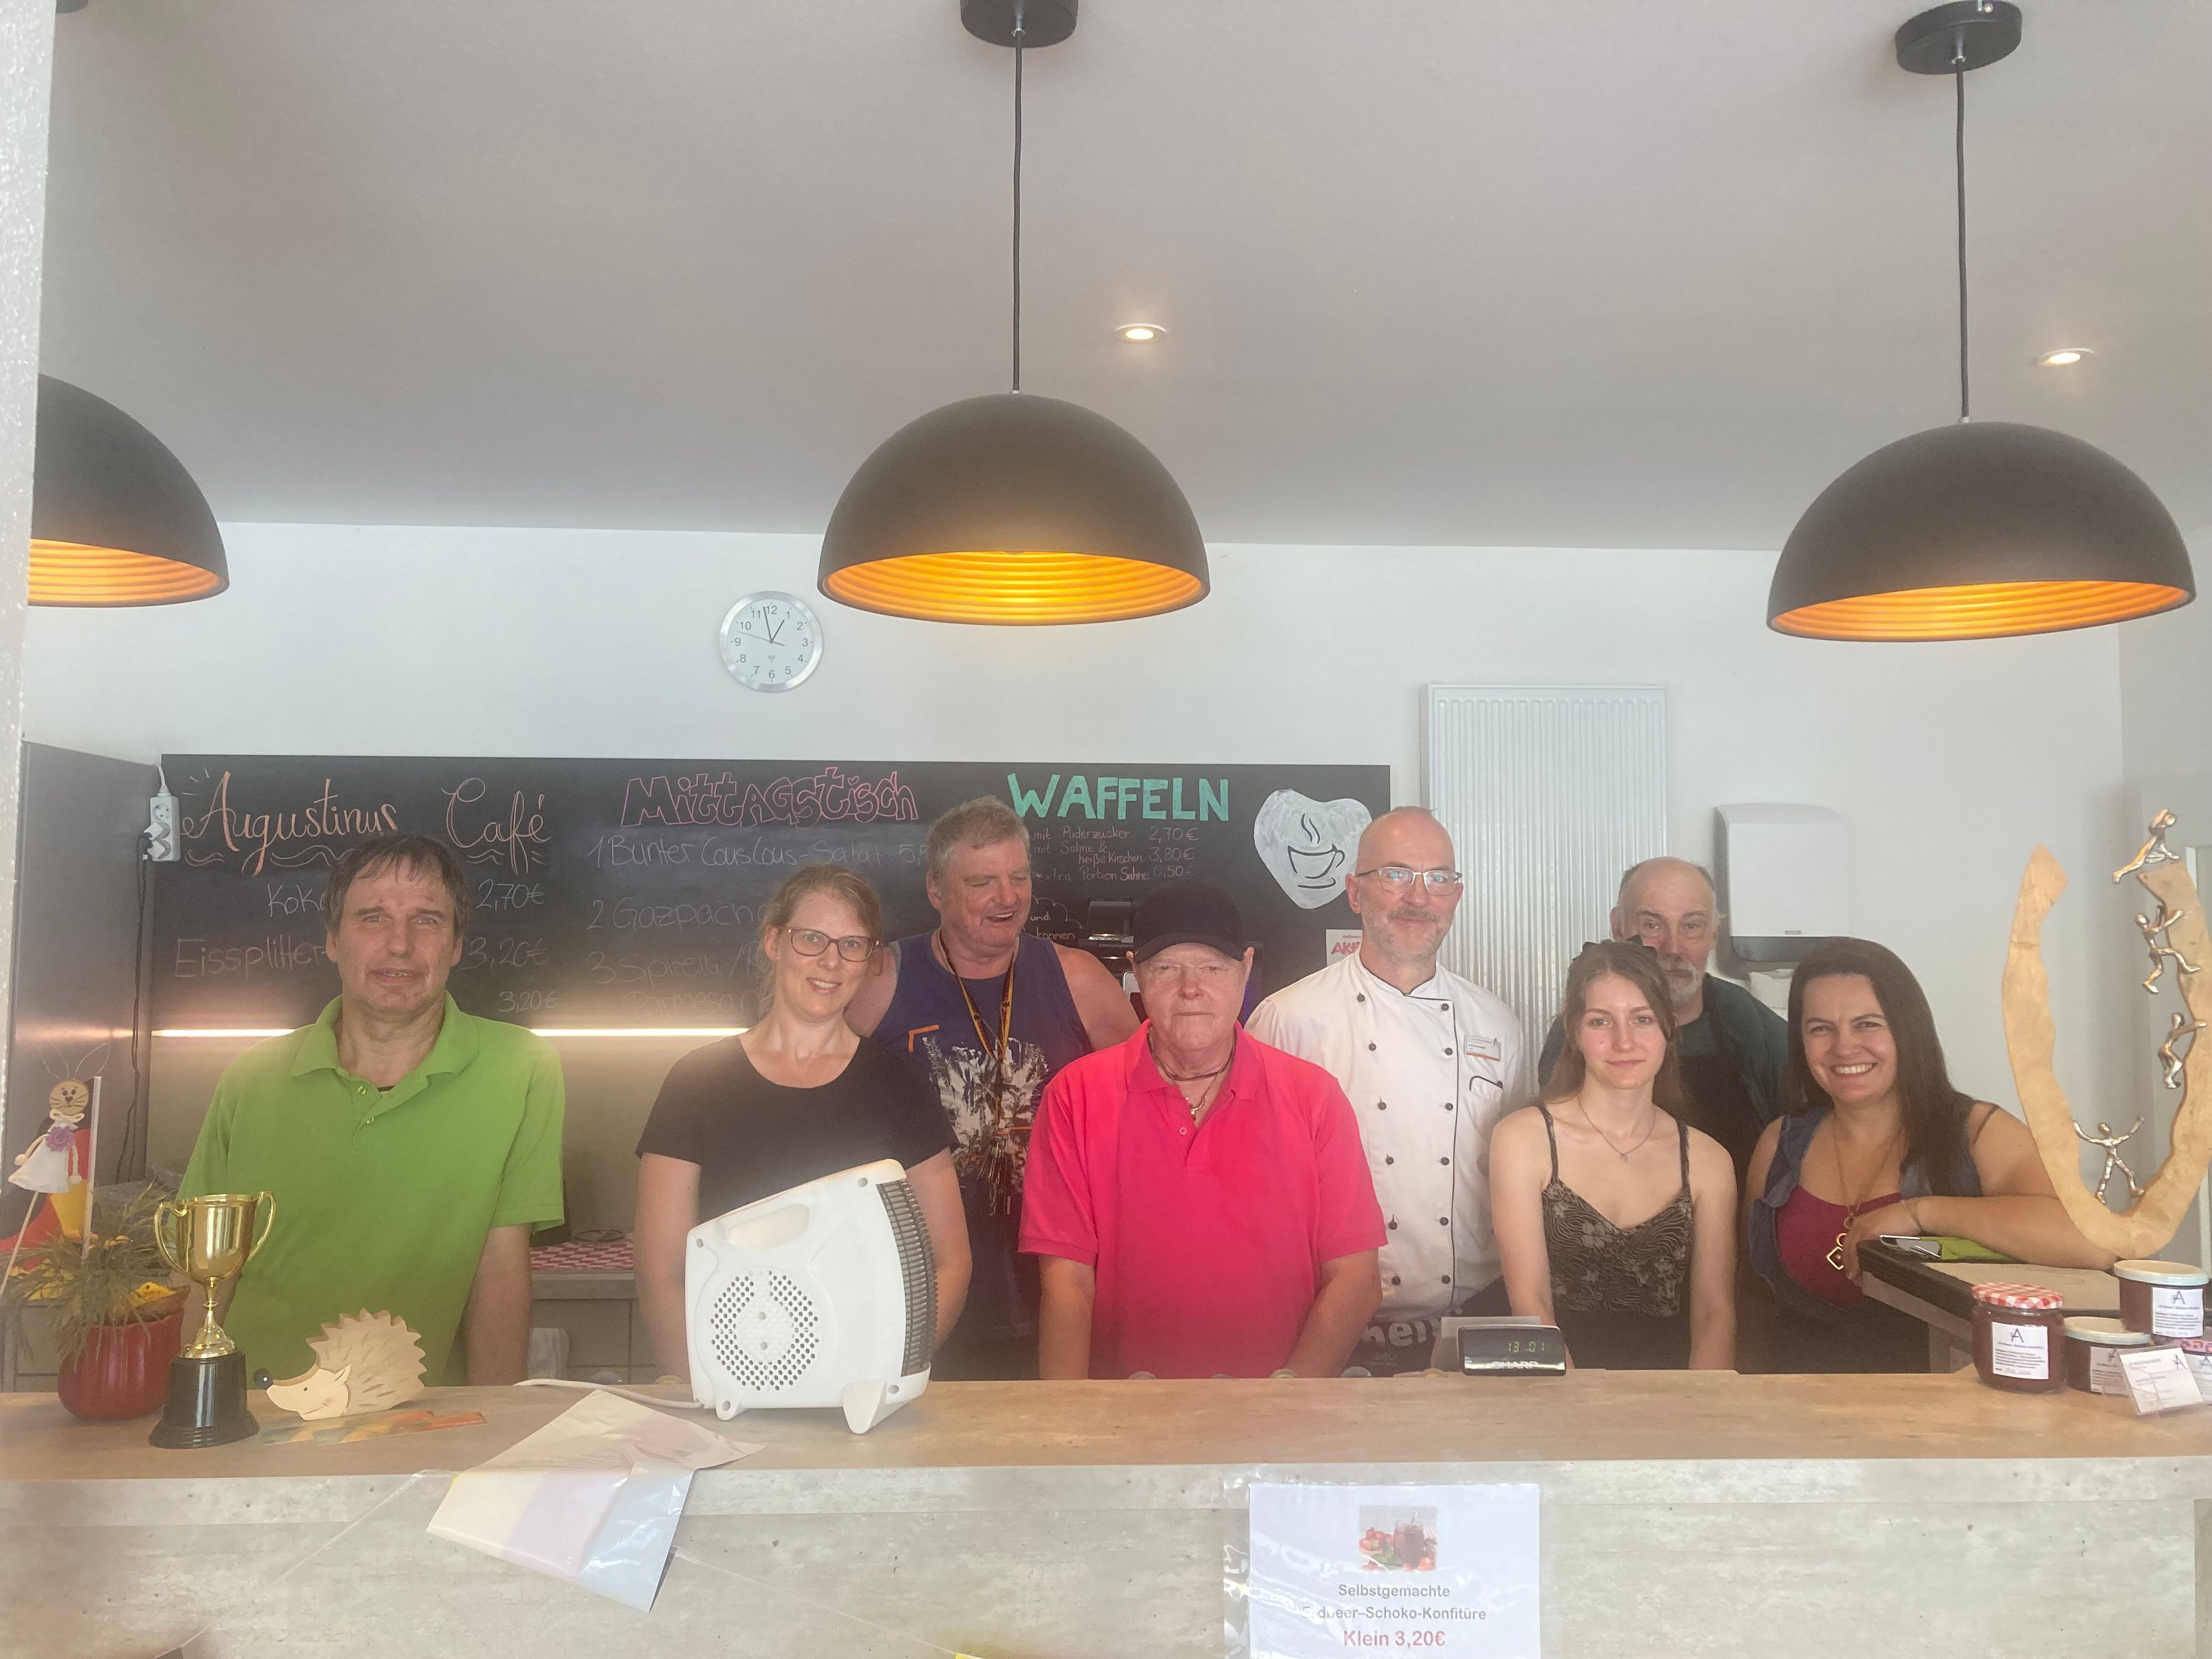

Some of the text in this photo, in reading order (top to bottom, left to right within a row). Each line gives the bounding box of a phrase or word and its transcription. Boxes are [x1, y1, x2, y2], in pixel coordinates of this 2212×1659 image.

[751, 610, 761, 619] 11
[766, 606, 778, 614] 12
[786, 611, 790, 619] 1
[740, 622, 752, 630] 10
[797, 622, 803, 630] 2
[734, 637, 741, 646] 9
[802, 638, 808, 646] 3
[740, 654, 746, 663] 8
[797, 654, 804, 662] 4
[753, 666, 760, 675] 7
[769, 670, 775, 679] 6
[785, 666, 791, 675] 5
[1007, 773, 1229, 821] WAFFELN
[180, 771, 552, 875] Augustinus Café
[1061, 826, 1130, 840] Puderzucker
[1149, 827, 1199, 843] 2,70€
[608, 835, 695, 867] Bunter
[1060, 841, 1094, 854] Sahne
[1098, 840, 1107, 854] &
[1078, 847, 1195, 867] heiße Kirschen 3,80€
[1079, 866, 1117, 880] Portion
[1120, 867, 1151, 881] Sahne
[476, 879, 544, 911] 2,70€
[1338, 1584, 1450, 1599] Selbstgemachte
[1344, 1631, 1446, 1649] Klein 3,20€
